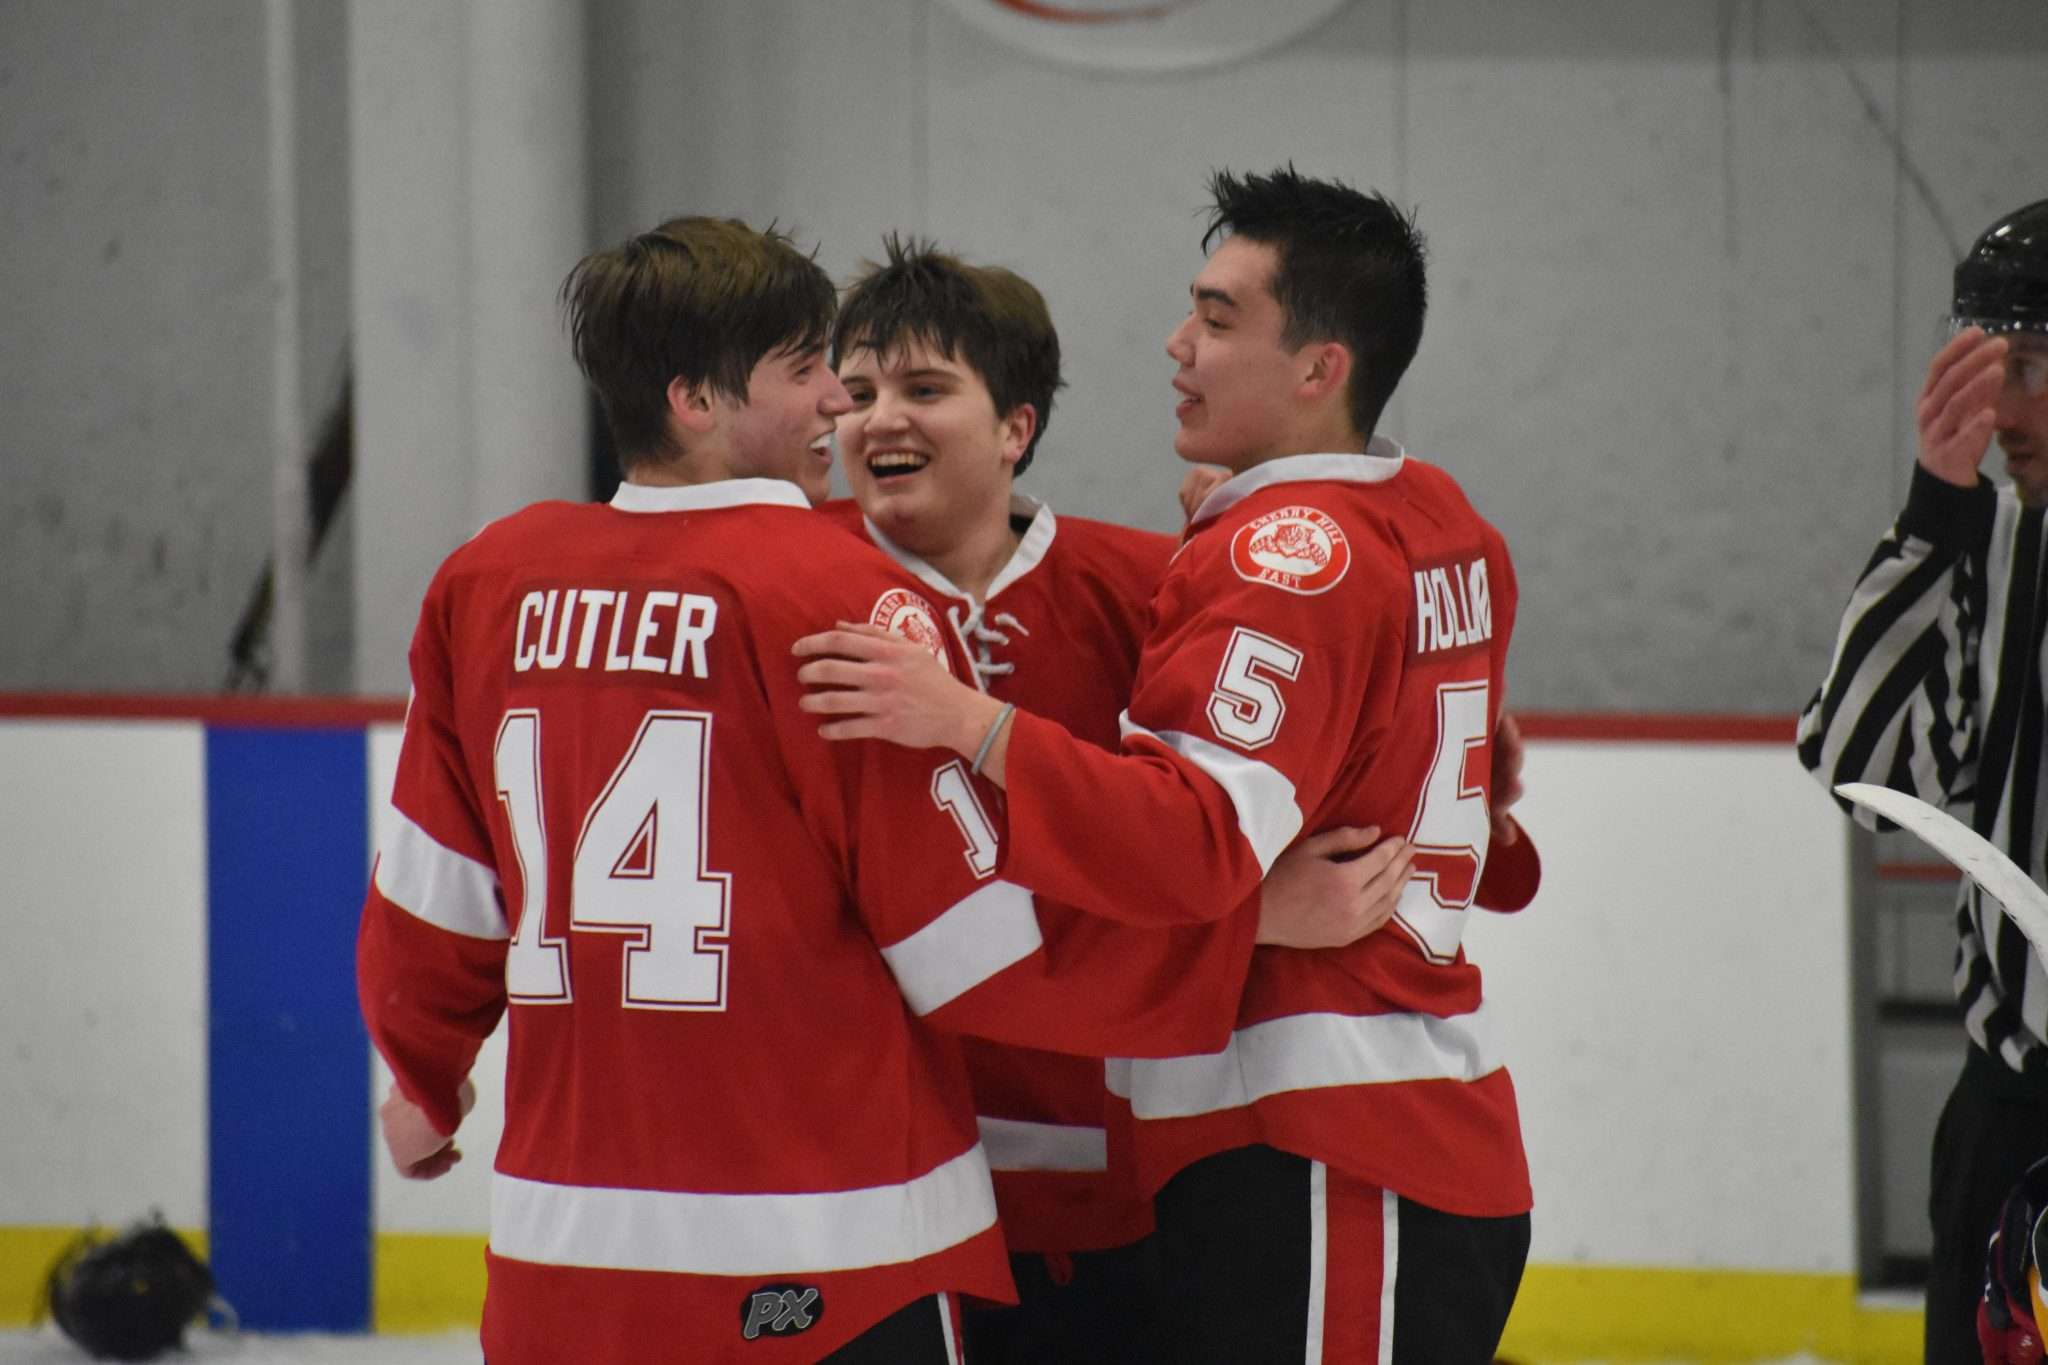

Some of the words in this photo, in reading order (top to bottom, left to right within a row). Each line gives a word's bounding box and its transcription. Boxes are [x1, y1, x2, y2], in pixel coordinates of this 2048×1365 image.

[514, 589, 719, 678] CUTLER
[1206, 626, 1304, 751] 5
[495, 709, 733, 1012] 14
[1392, 679, 1491, 966] 5
[744, 1287, 819, 1340] PX
